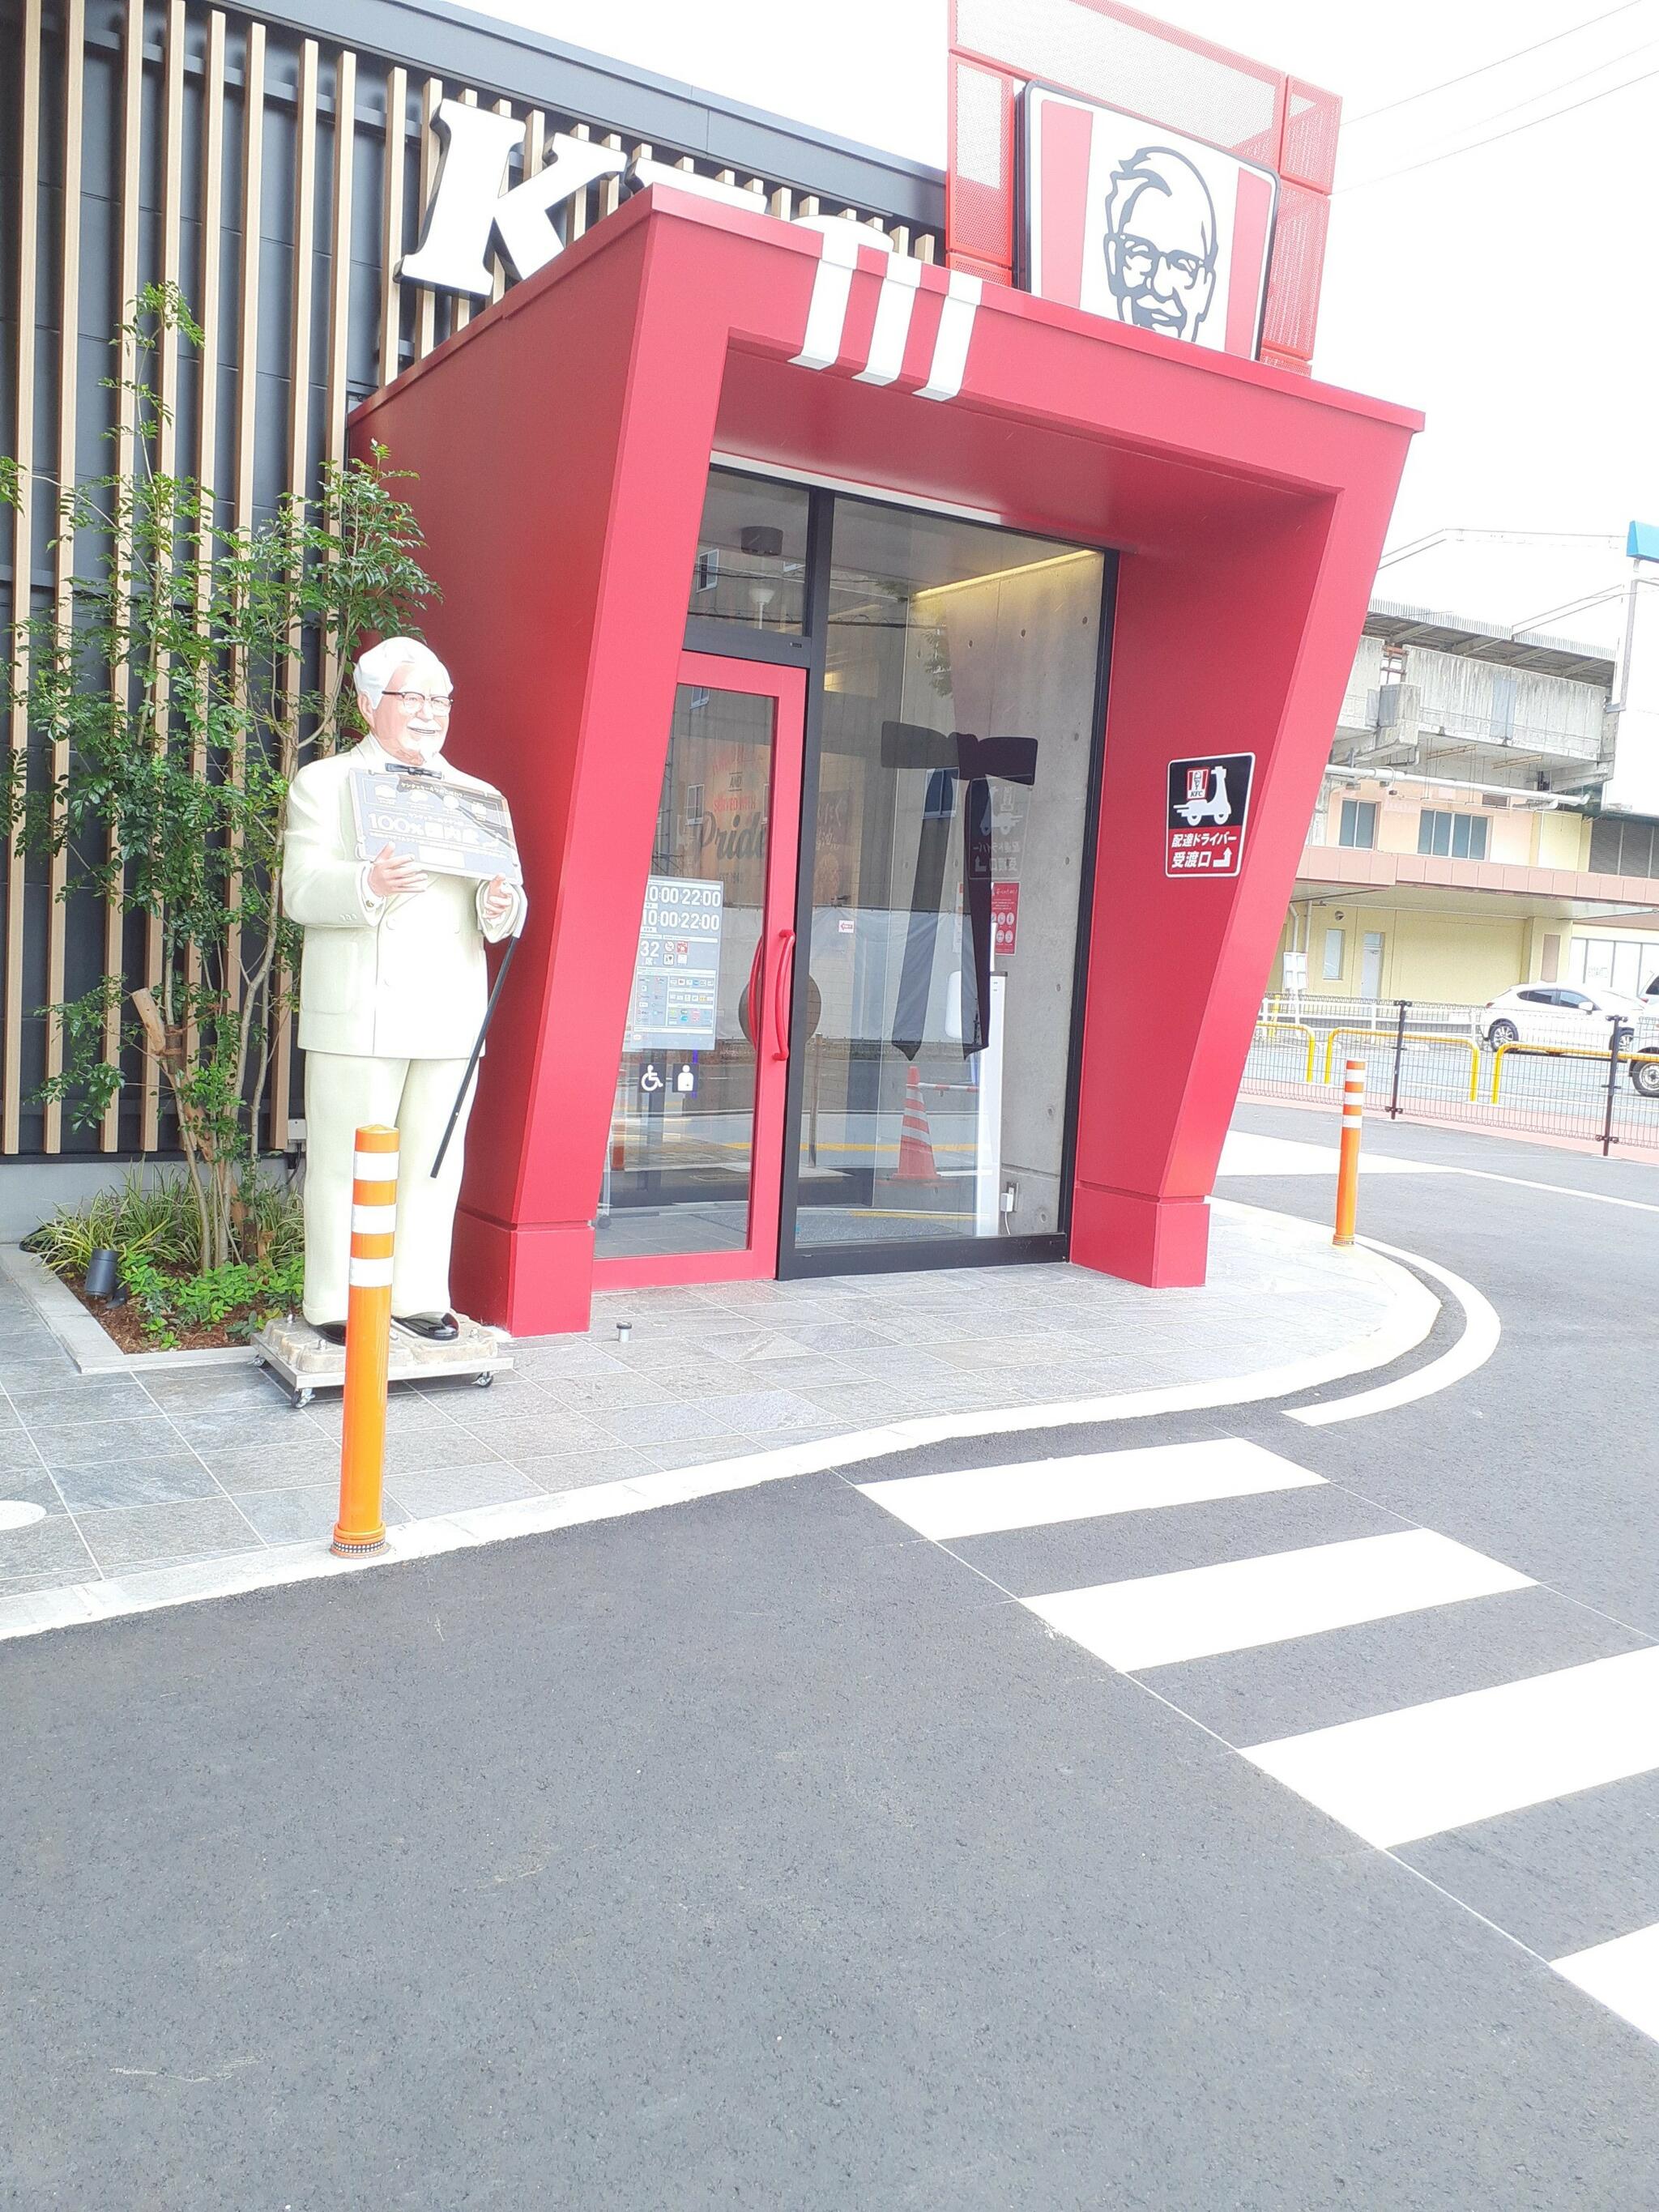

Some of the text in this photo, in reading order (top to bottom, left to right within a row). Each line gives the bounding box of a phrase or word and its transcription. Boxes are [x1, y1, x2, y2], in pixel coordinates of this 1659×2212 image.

[730, 777, 742, 788] AND
[1171, 831, 1237, 847] 配達ドライバー
[1171, 851, 1212, 868] 受渡口
[681, 889, 721, 907] 22:00
[643, 909, 719, 931] 10:00 22:00
[640, 940, 659, 957] 32
